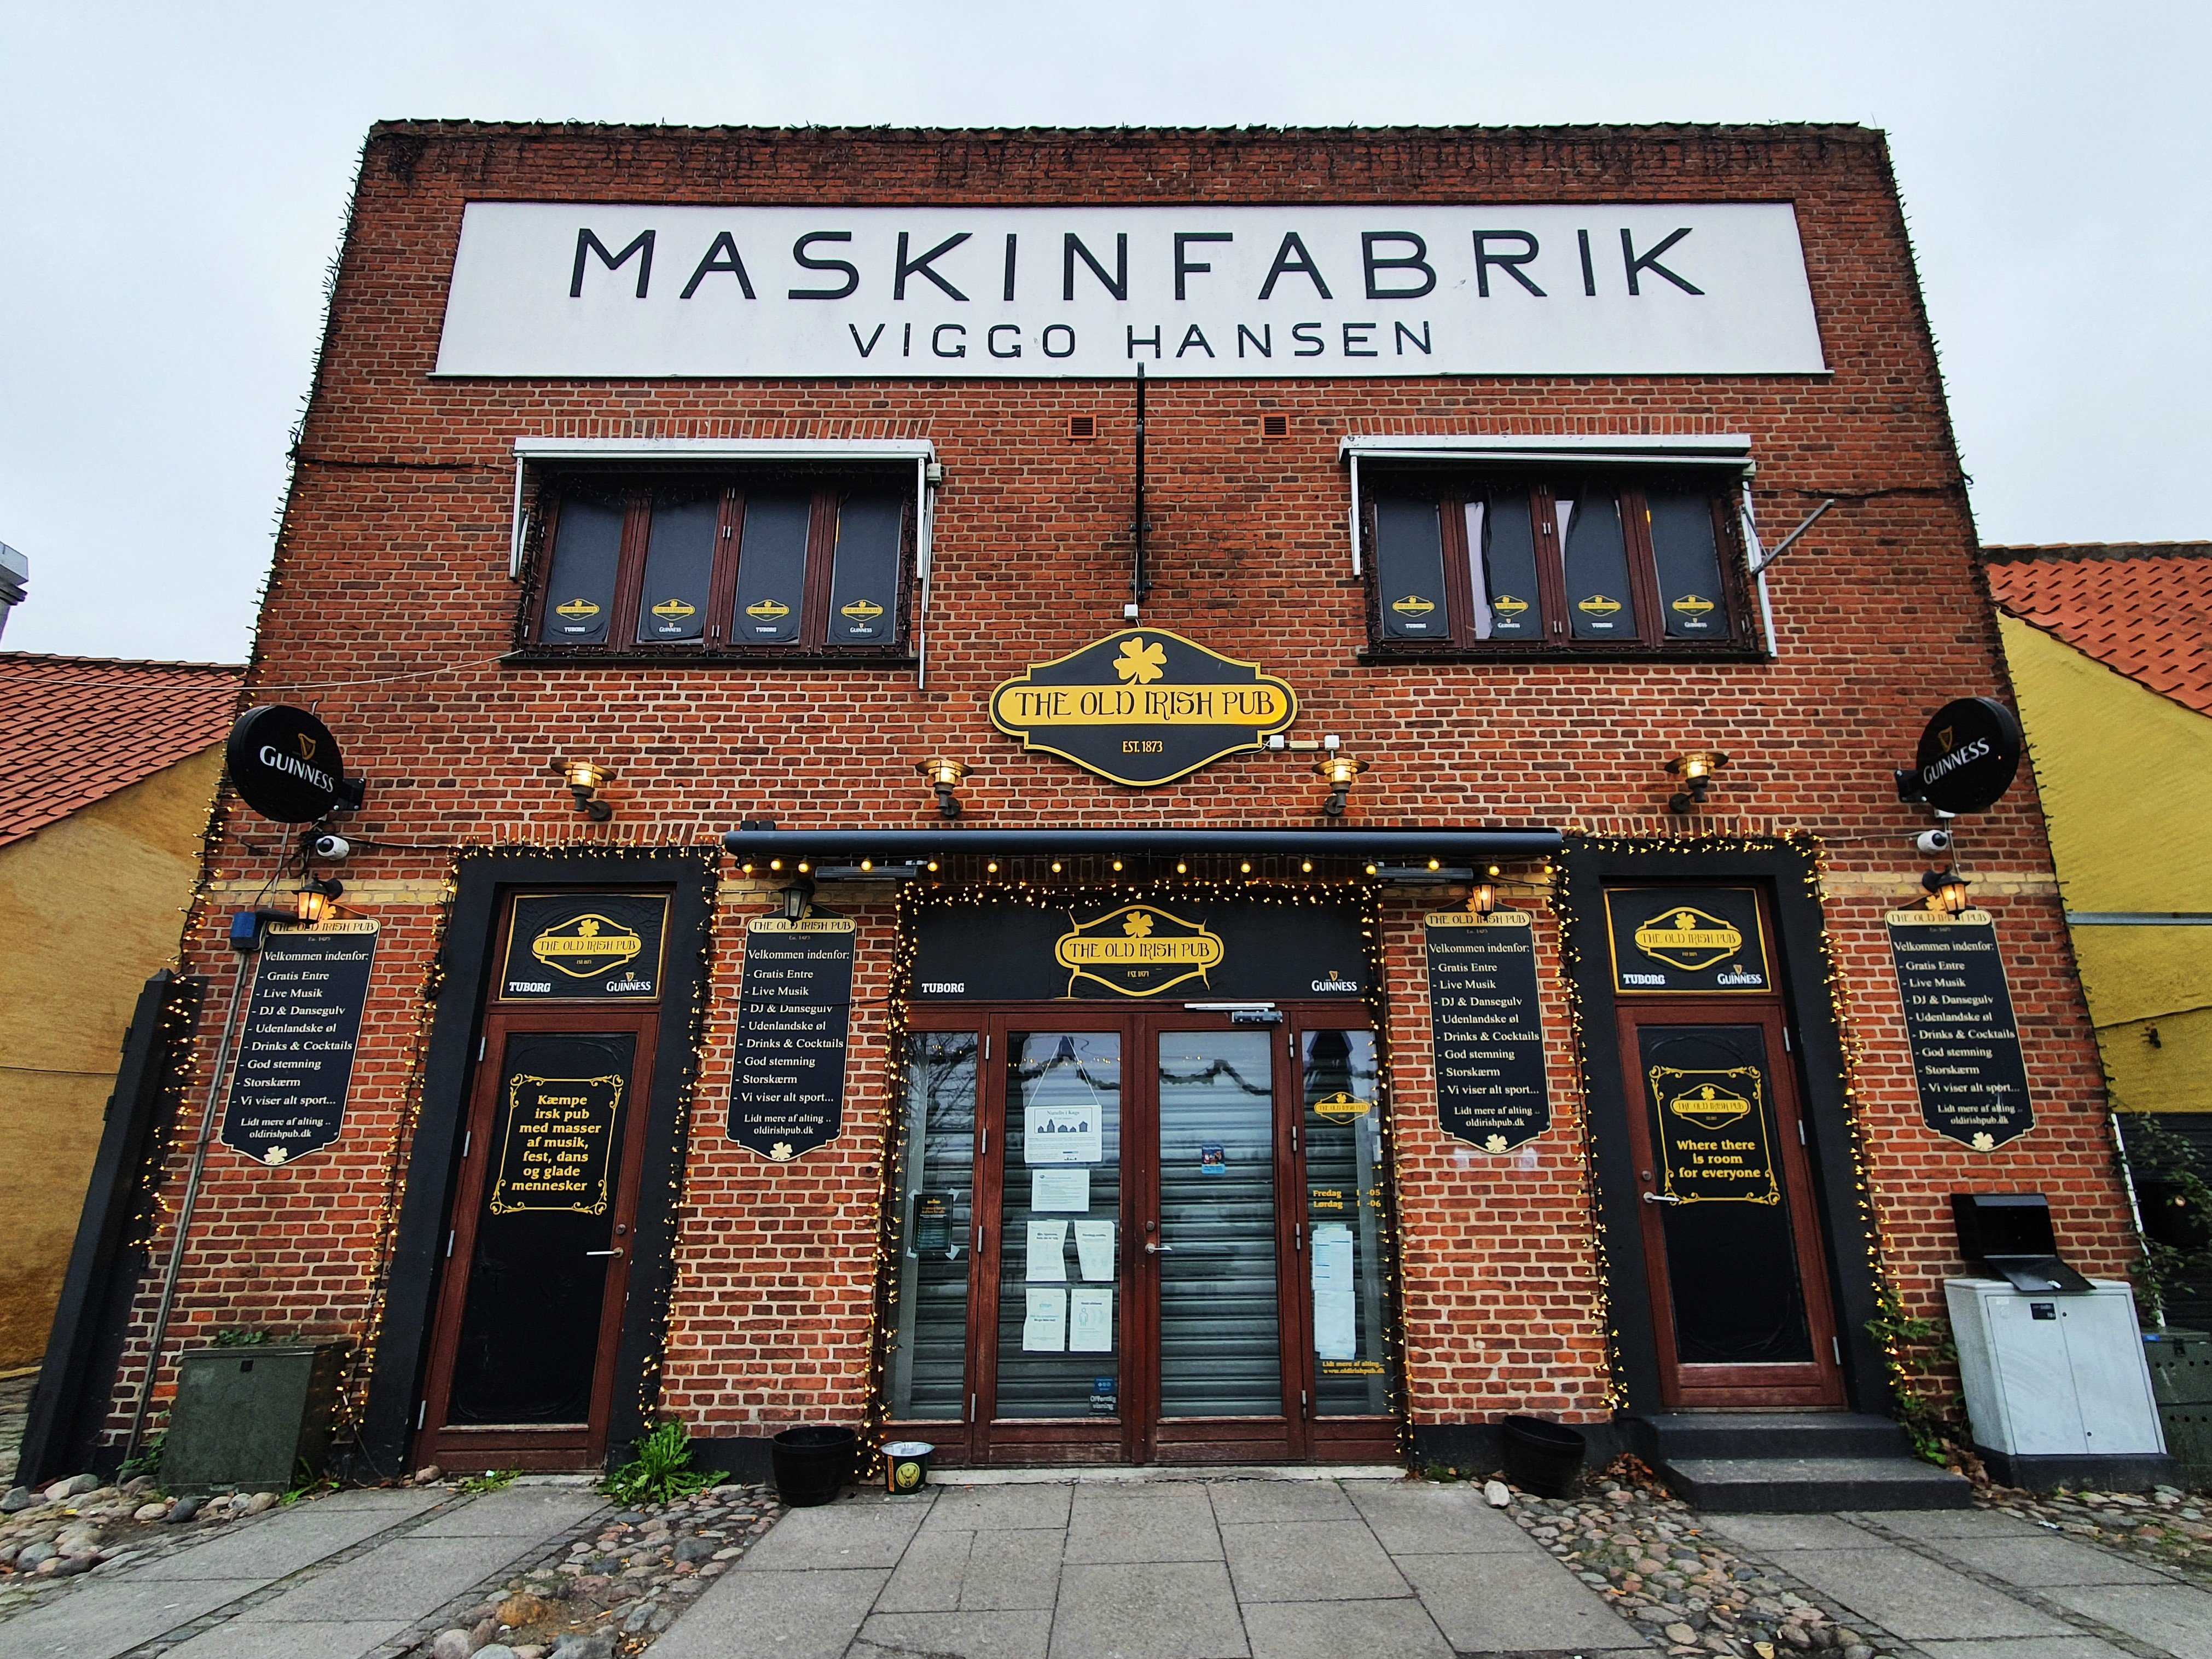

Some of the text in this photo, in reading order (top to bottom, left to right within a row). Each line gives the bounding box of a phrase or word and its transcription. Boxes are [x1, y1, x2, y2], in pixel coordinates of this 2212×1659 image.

[569, 228, 1705, 301] MASKINFABRIK
[849, 321, 1432, 359] VIGGO HANSEN
[1015, 691, 1275, 721] THE OLD IRISH PUB
[1123, 741, 1163, 753] EST. 1873
[1923, 738, 1989, 785] GUINNESS
[259, 745, 334, 792] GUINNESS
[1641, 933, 1736, 945] THE OLD IRISH PUB
[539, 940, 636, 953] THE OLD IRISH PUB
[1429, 944, 1484, 953] Velkommen
[1894, 941, 1950, 951] Velkommen
[265, 952, 322, 960] Velkommen
[748, 949, 804, 959] Velkommen
[1070, 943, 1210, 960] THE OLD IRISH PUB
[1438, 963, 1497, 972] Gratis Entre
[1906, 961, 1965, 970] Gratis Entre
[268, 972, 298, 980] Gratis
[754, 970, 783, 978] Gratis
[1623, 973, 1665, 984] TUBORG
[1717, 973, 1762, 984] GUINNESS
[509, 982, 551, 993] TUBORG
[606, 981, 651, 992] GUINNESS
[1311, 981, 1357, 991] GUINNESS
[1440, 980, 1496, 989] Live Musik
[1909, 978, 1966, 987] Live Musik
[263, 989, 322, 997] Live Musik
[752, 987, 809, 995] Live Musik
[922, 983, 964, 993] TUBORG
[1442, 997, 1522, 1007] DJ & Dansegulv
[1913, 995, 1993, 1006] DJ & Dansegulv
[259, 1006, 345, 1017] DJ & Dansegulv
[780, 1005, 832, 1014] Dansegulv
[1443, 1014, 1518, 1023] Udenlandske øl
[1916, 1012, 1992, 1022] Udenlandske øl
[256, 1023, 336, 1032] Udenlandske øl
[749, 1021, 826, 1030] Udenlandske øl
[1444, 1031, 1539, 1041] Drinks & Cocktails
[1919, 1029, 2014, 1039] Drinks & Cocktails
[252, 1041, 352, 1051] Drinks & Cocktails
[747, 1039, 843, 1047] Drinks & Cocktails
[1445, 1049, 1515, 1060] God stemning
[1922, 1047, 1993, 1058] God stemning
[248, 1059, 321, 1070] God stemning
[745, 1057, 815, 1068] God stemning
[1447, 1068, 1500, 1076] Storskærm
[1925, 1065, 1979, 1074] Storskærm
[243, 1077, 300, 1087] Storskærm
[743, 1075, 797, 1083] Storskærm
[1447, 1086, 1459, 1094] Vi
[1462, 1085, 1487, 1094] viser
[1490, 1085, 1502, 1094] alt
[241, 1096, 252, 1105] Vi
[256, 1096, 281, 1105] viser
[284, 1095, 297, 1104] alt
[537, 1095, 588, 1108] Kæmpe
[741, 1093, 752, 1101] Vi
[756, 1093, 781, 1101] viser
[783, 1092, 796, 1101] alt
[535, 1108, 589, 1122] irsk pub
[1508, 1106, 1532, 1116] alting
[298, 1117, 323, 1127] alting
[799, 1114, 823, 1123] alting
[1466, 1118, 1524, 1128] oldirishpub.dk
[519, 1123, 601, 1133] med masser
[754, 1126, 813, 1135] oldirishpub.dk
[249, 1129, 311, 1139] oldirishpub.dk
[527, 1136, 589, 1150] af musik,
[1676, 1139, 1756, 1150] Where there
[522, 1151, 589, 1164] fest, dans
[1693, 1153, 1743, 1164] is room
[523, 1165, 580, 1179] og glade
[1679, 1167, 1761, 1181] for everyone
[512, 1180, 588, 1191] mennesker
[1313, 1190, 1342, 1199] Fredag
[1313, 1200, 1343, 1209] Lørdag
